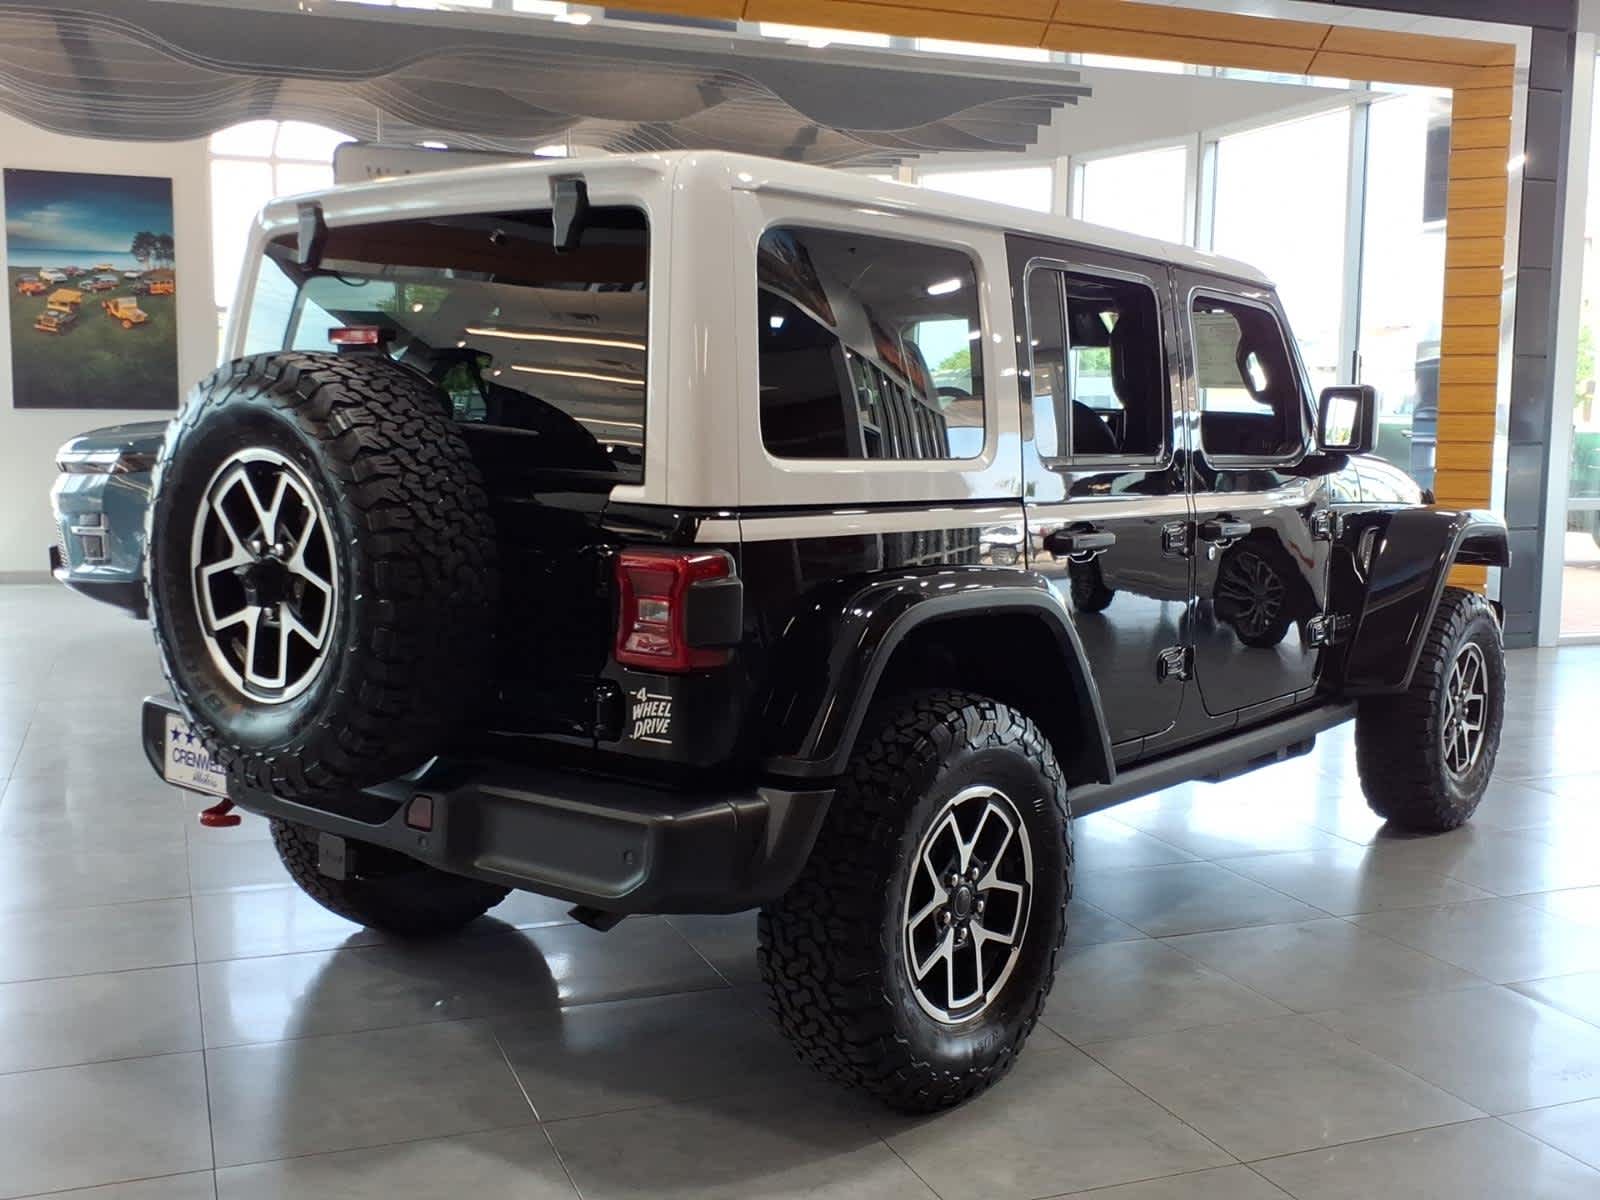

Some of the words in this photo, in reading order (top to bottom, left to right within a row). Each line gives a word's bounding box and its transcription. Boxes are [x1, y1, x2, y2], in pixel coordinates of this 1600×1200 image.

[636, 687, 648, 702] 4
[632, 701, 672, 720] WHEEL
[632, 718, 672, 740] DRIVE
